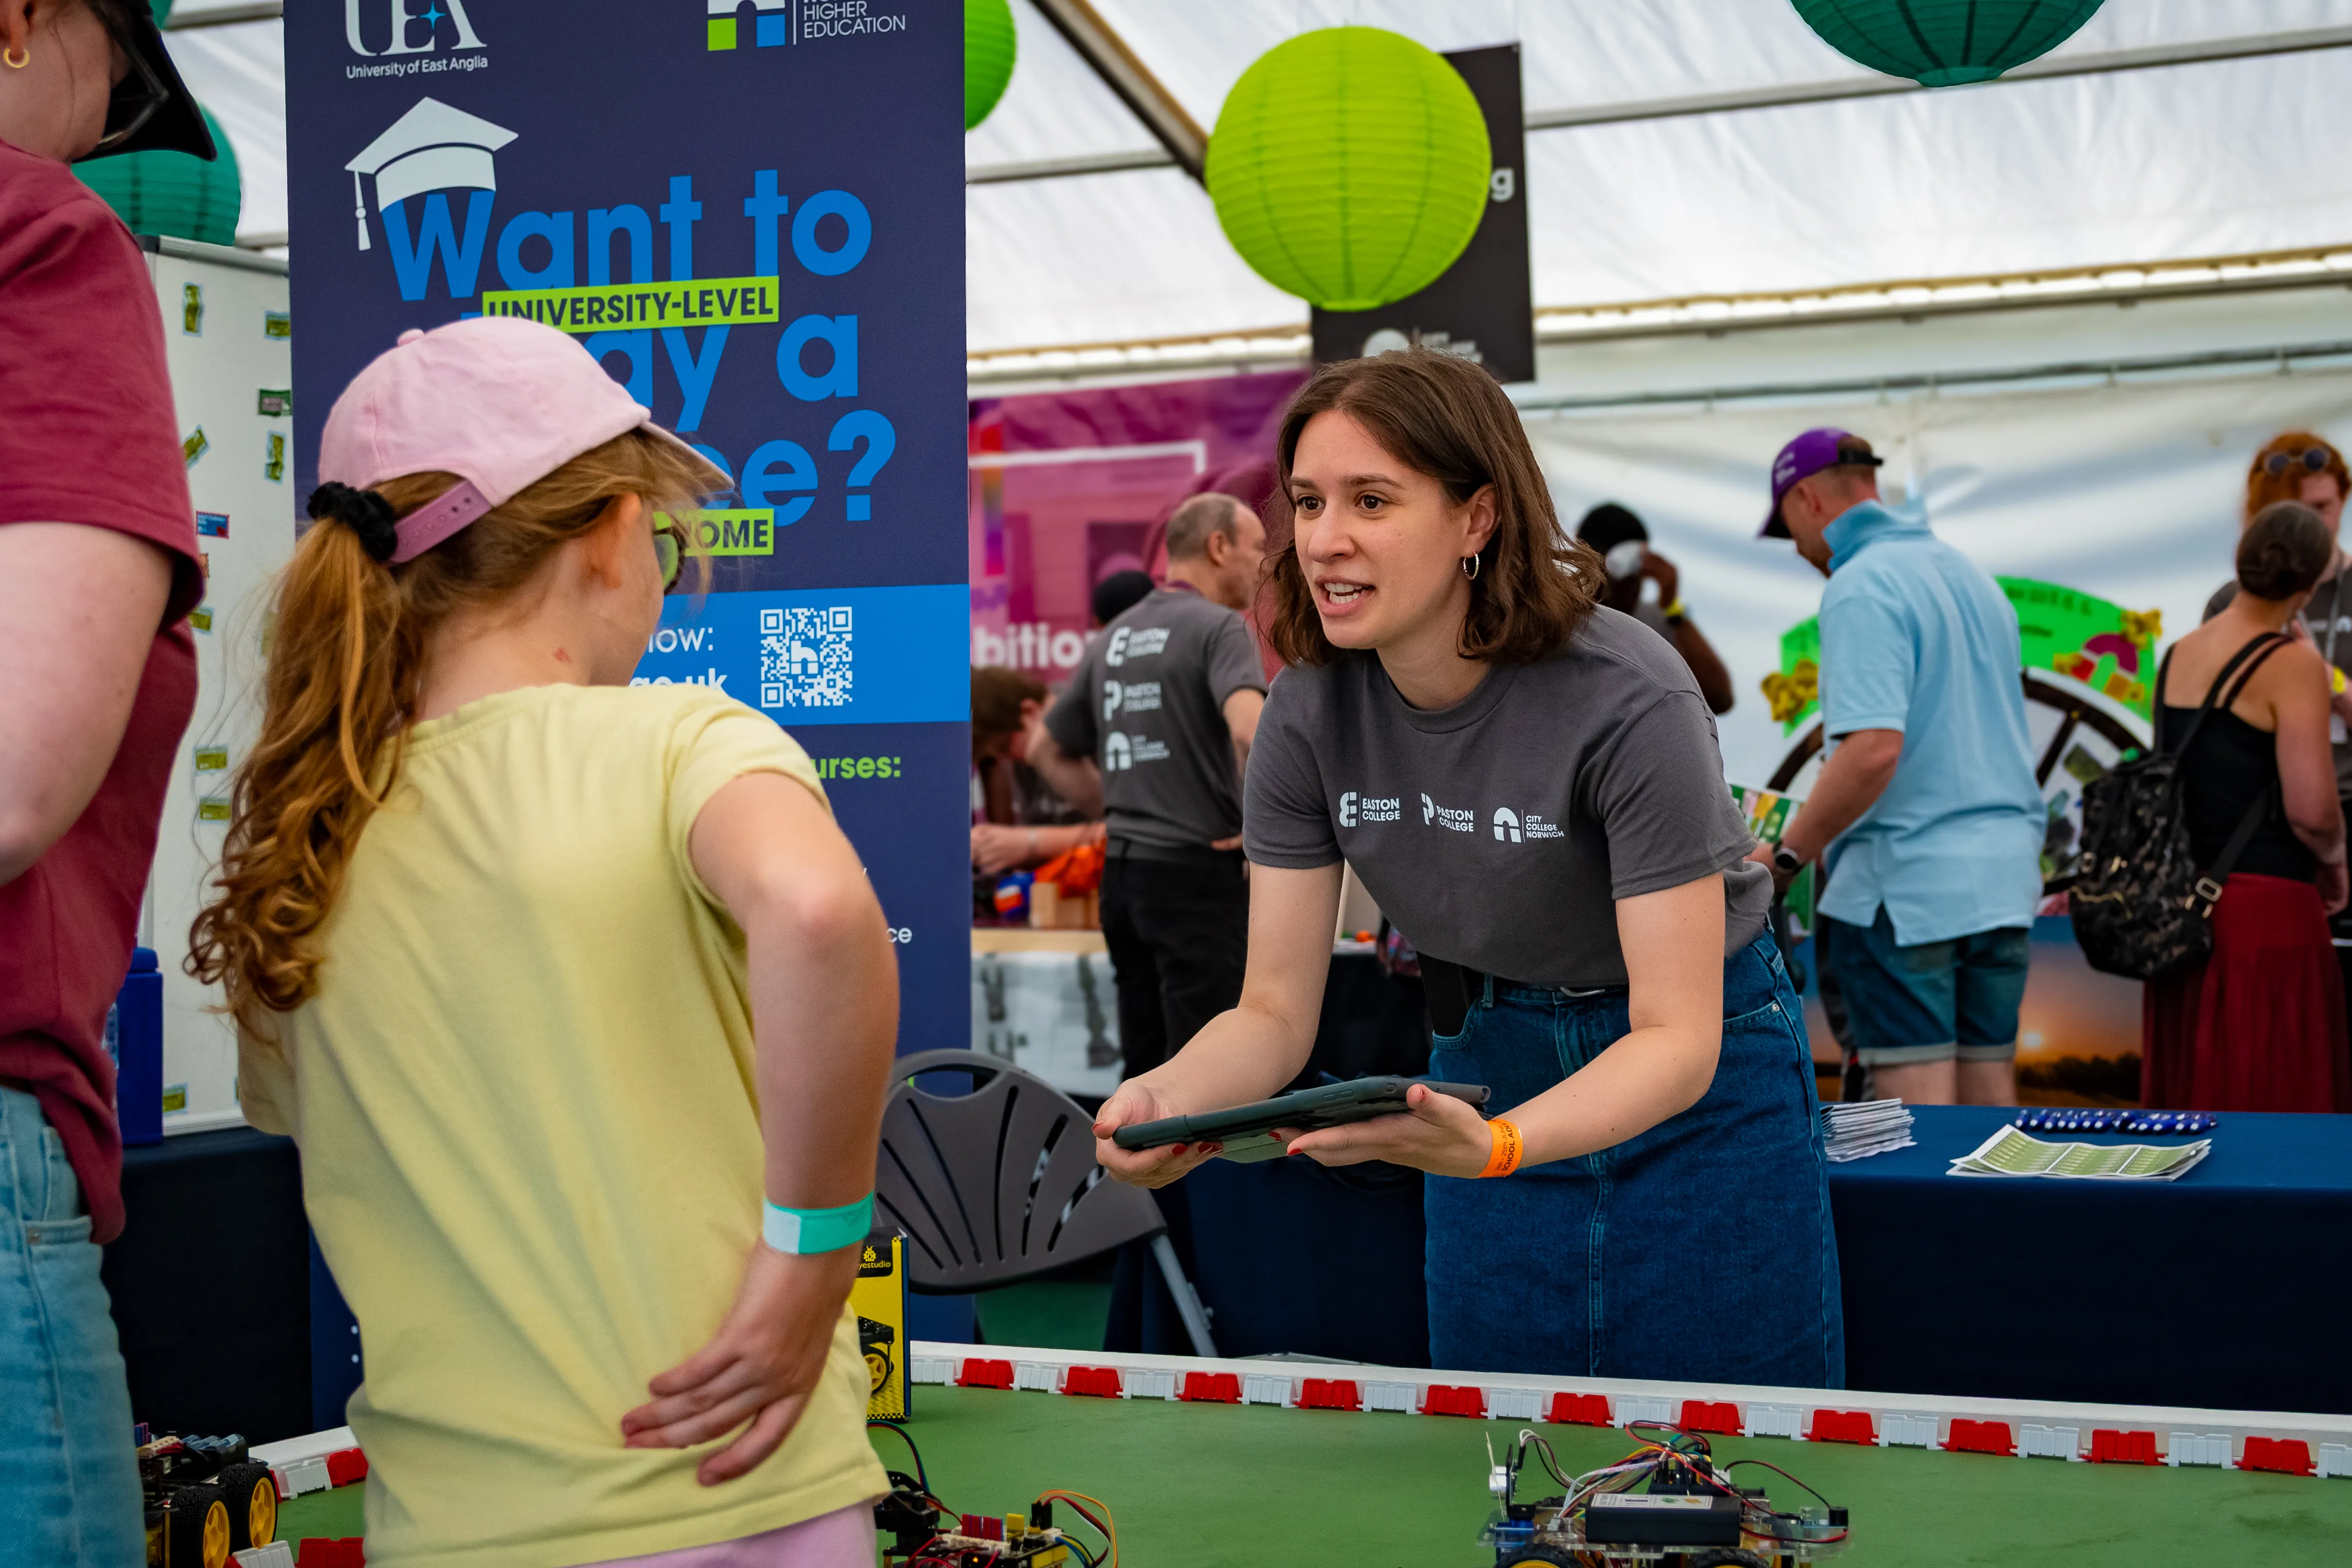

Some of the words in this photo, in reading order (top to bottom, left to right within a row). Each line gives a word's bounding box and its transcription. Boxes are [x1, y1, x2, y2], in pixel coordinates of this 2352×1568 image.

[803, 1, 867, 21] HIGHER
[803, 14, 906, 38] EDUCATION
[346, 62, 406, 79] University
[407, 59, 420, 73] of
[421, 58, 448, 73] East
[449, 55, 488, 71] Anglia
[381, 175, 702, 302] Want
[744, 169, 872, 277] to
[776, 314, 858, 402] a
[973, 621, 1099, 670] bitio
[1362, 798, 1400, 810] EASTON
[1436, 805, 1473, 821] PASTON
[1362, 811, 1401, 821] COLLEGE
[1439, 817, 1474, 832] COLLEGE
[1526, 823, 1558, 831] COLLEGE
[1526, 830, 1565, 838] NORWICH
[1501, 1141, 1515, 1171] SCHOOL
